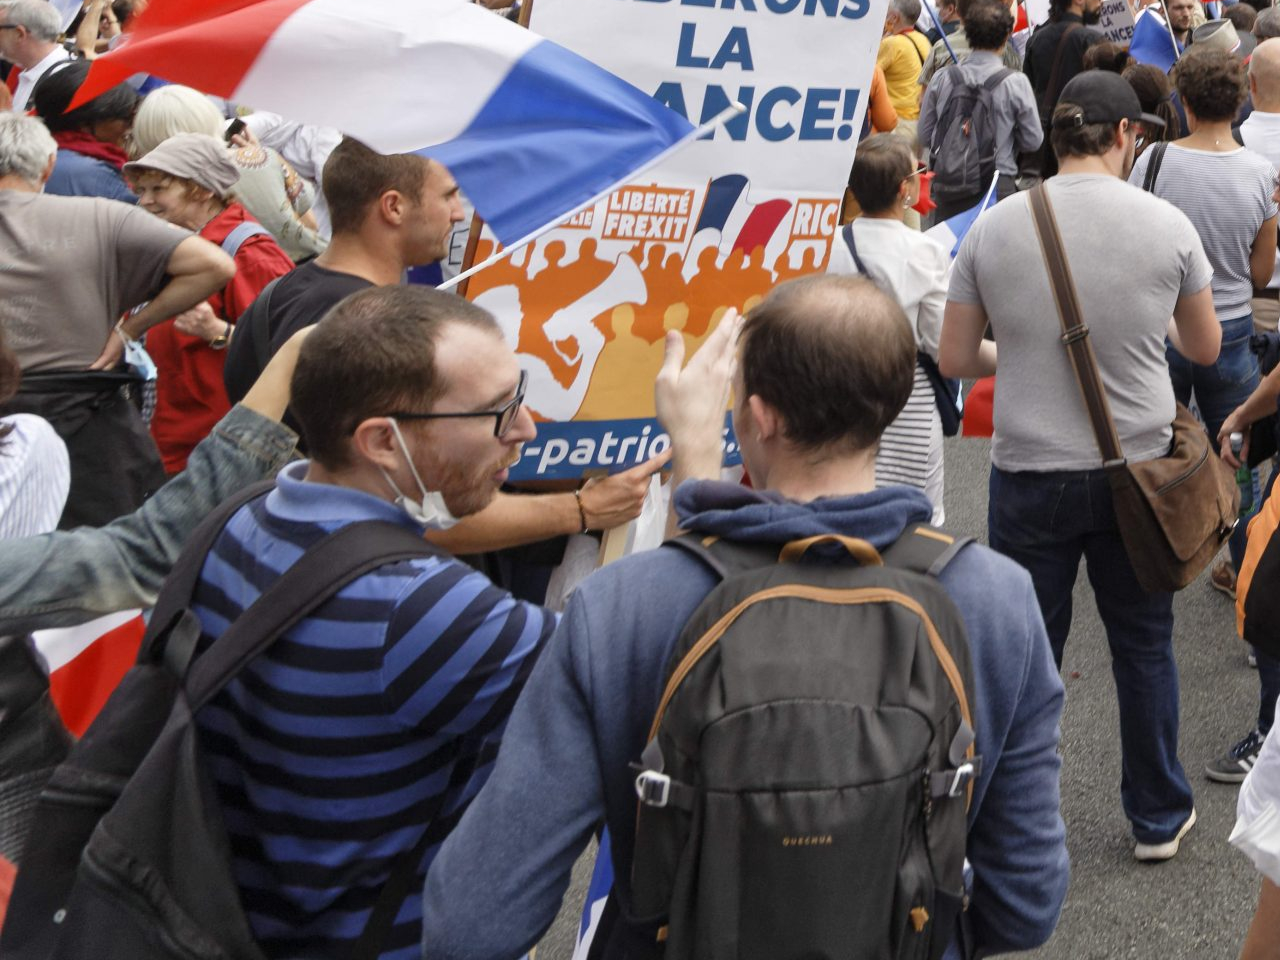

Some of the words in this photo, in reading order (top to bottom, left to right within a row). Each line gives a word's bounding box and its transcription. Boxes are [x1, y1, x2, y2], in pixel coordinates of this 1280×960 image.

[676, 22, 754, 71] LA
[651, 81, 860, 141] ANCE!
[610, 188, 691, 216] LIBERTÉ
[603, 213, 688, 239] FREXIT
[794, 204, 837, 236] RIC
